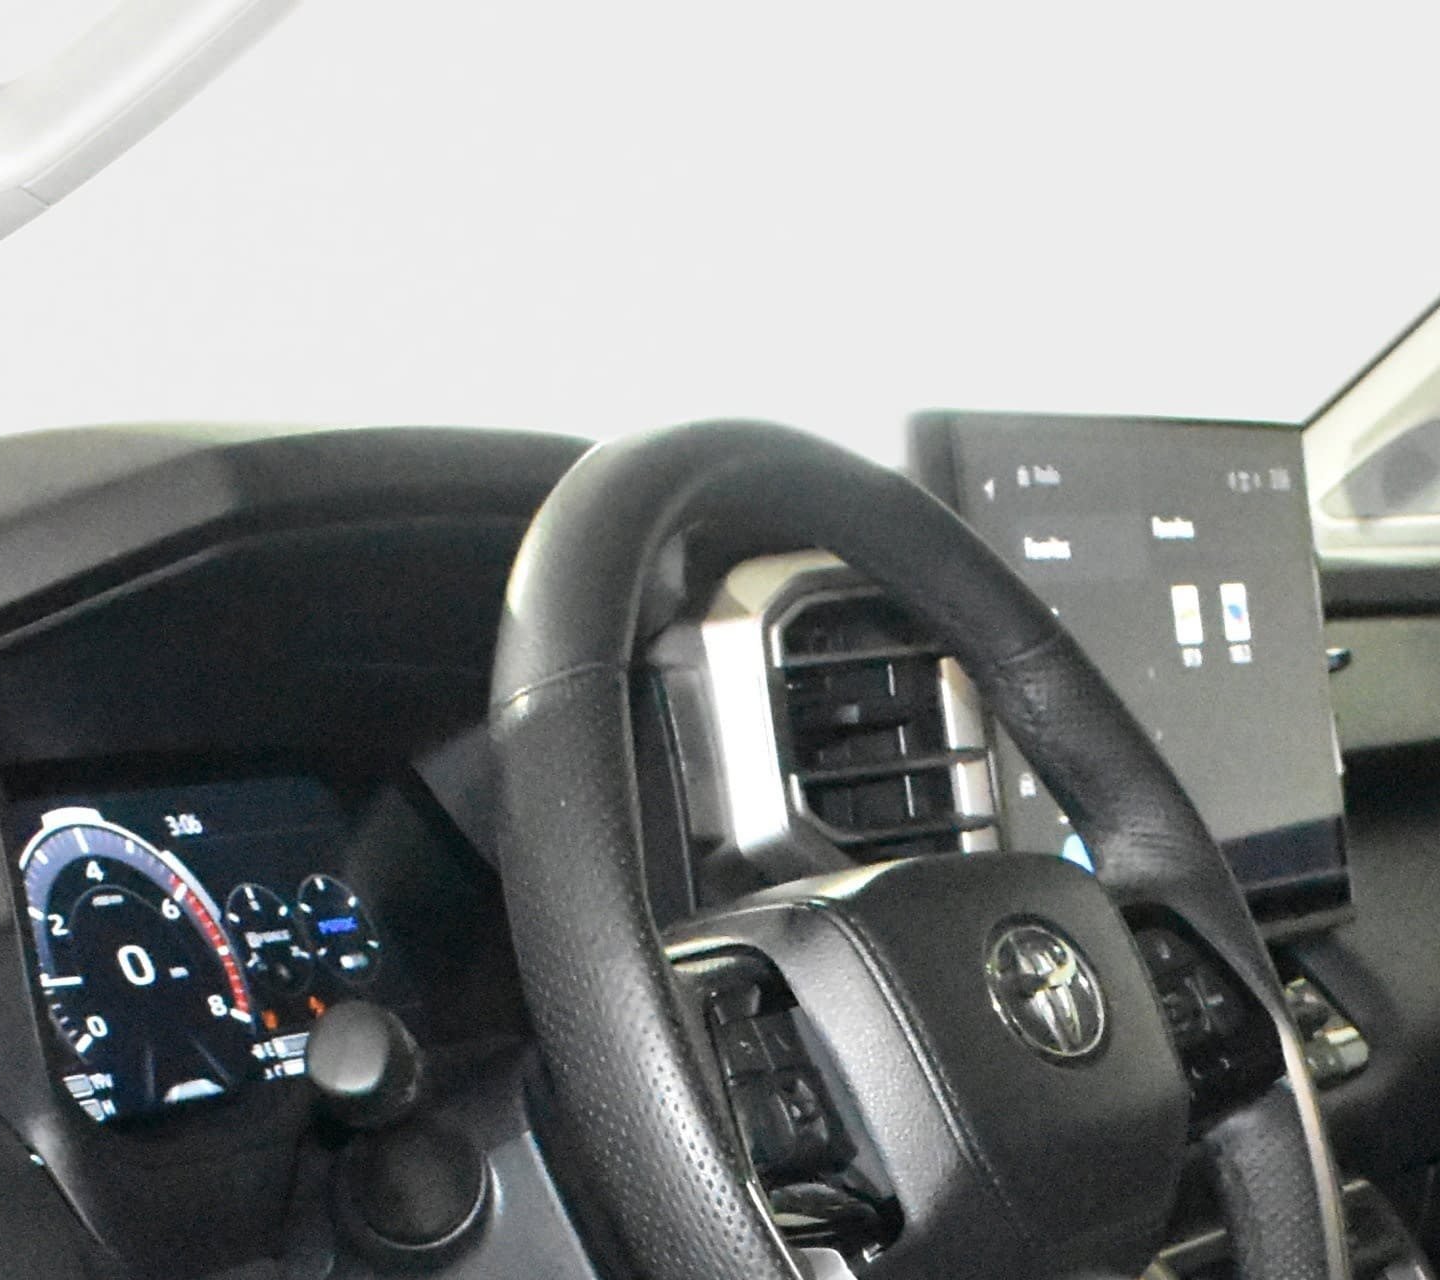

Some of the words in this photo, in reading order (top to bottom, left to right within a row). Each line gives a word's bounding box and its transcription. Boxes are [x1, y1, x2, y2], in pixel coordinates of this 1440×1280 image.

[85, 860, 104, 882] 4
[161, 898, 181, 920] 6
[46, 914, 69, 937] 2
[116, 944, 157, 986] 0
[207, 994, 228, 1017] 8
[86, 1014, 108, 1038] 0
